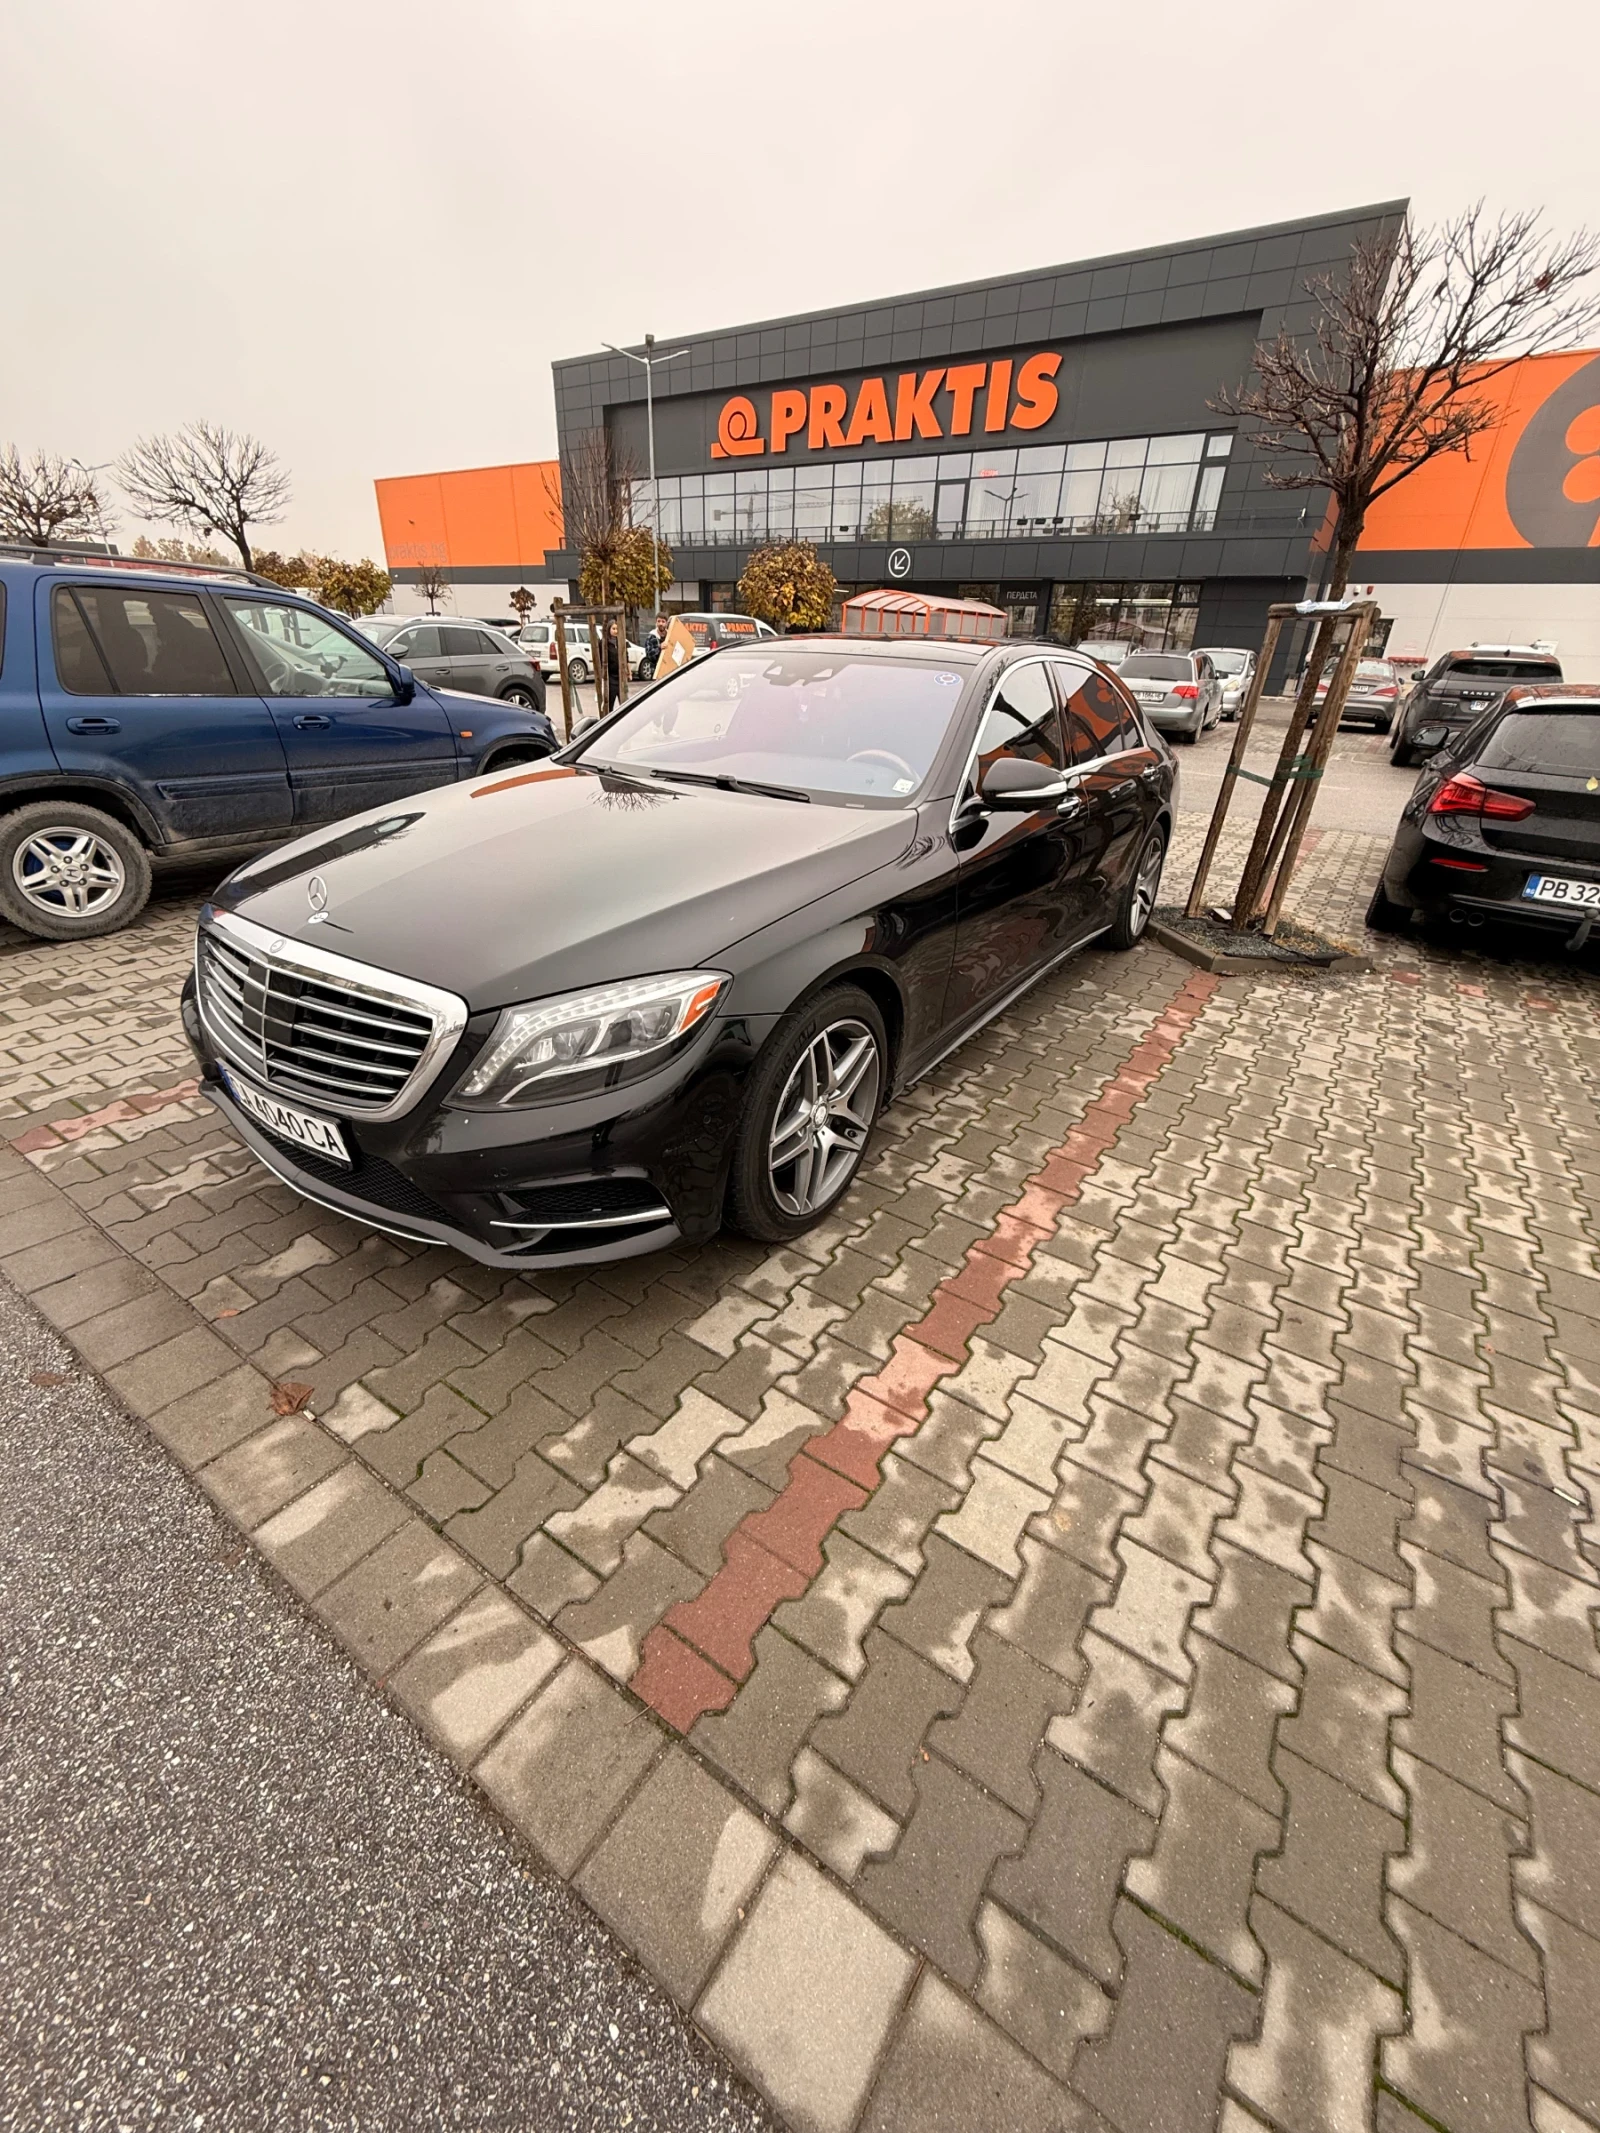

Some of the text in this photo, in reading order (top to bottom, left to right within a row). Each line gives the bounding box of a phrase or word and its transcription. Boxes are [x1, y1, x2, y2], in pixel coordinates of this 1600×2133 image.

[770, 352, 1063, 453] PRAKTIS
[1006, 591, 1038, 600] ПЕРДЕТА
[685, 623, 708, 632] AKTIS
[726, 622, 755, 632] PRAKTIS
[1538, 880, 1600, 905] PB 32
[254, 1095, 305, 1140] 4040
[303, 1119, 344, 1155] CA
